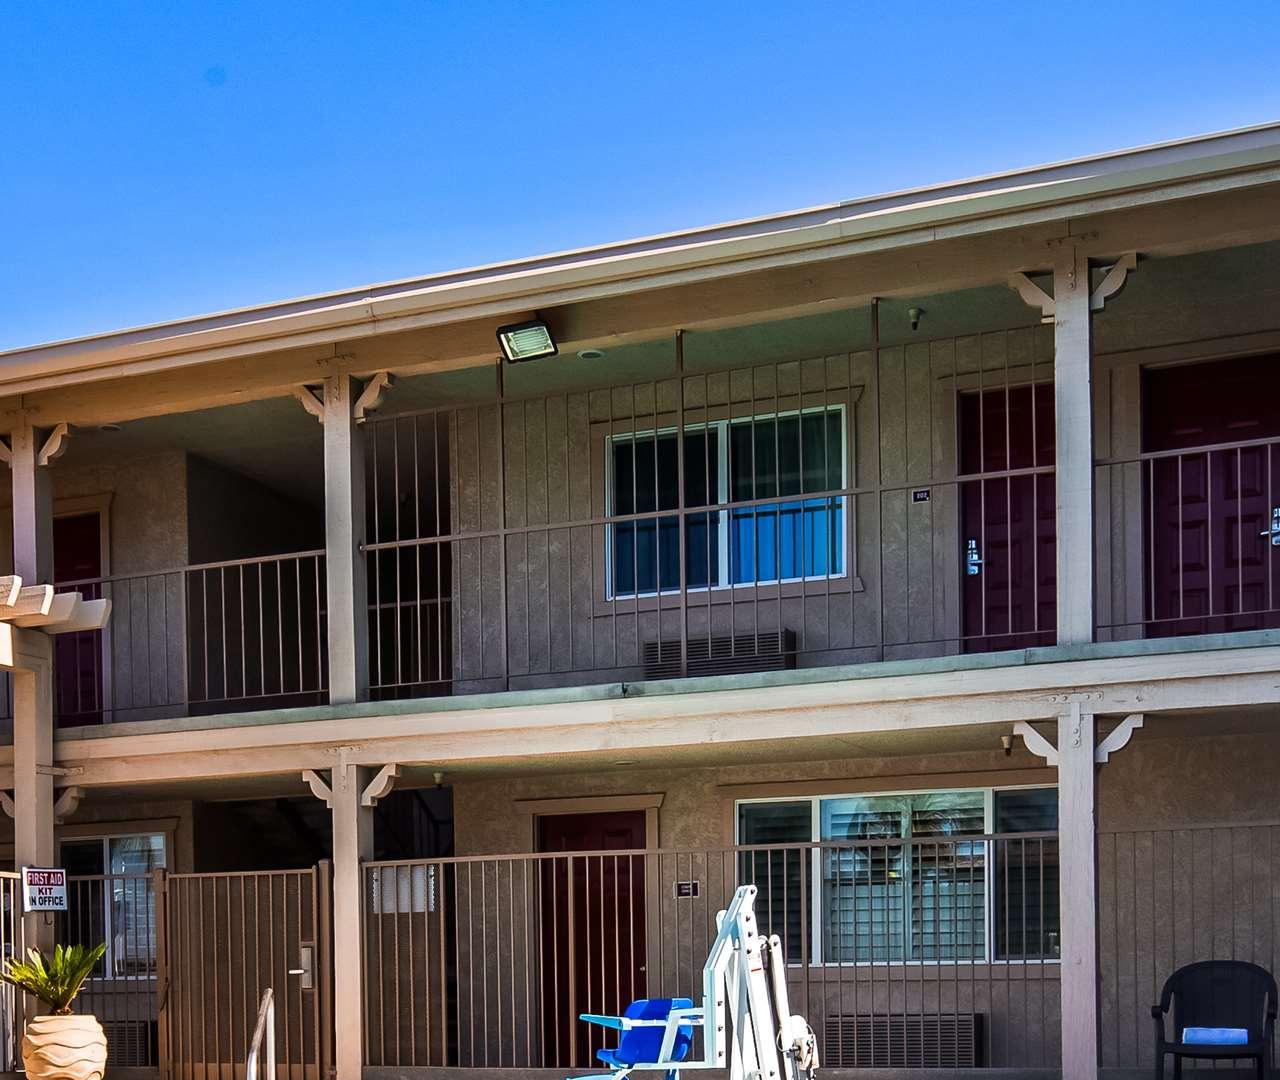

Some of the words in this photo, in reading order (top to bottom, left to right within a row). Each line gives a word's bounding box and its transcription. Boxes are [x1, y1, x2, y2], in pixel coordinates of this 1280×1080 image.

[27, 873, 48, 884] FIRST
[51, 873, 62, 884] AID
[38, 887, 53, 895] KIT
[38, 896, 64, 906] OFFICE
